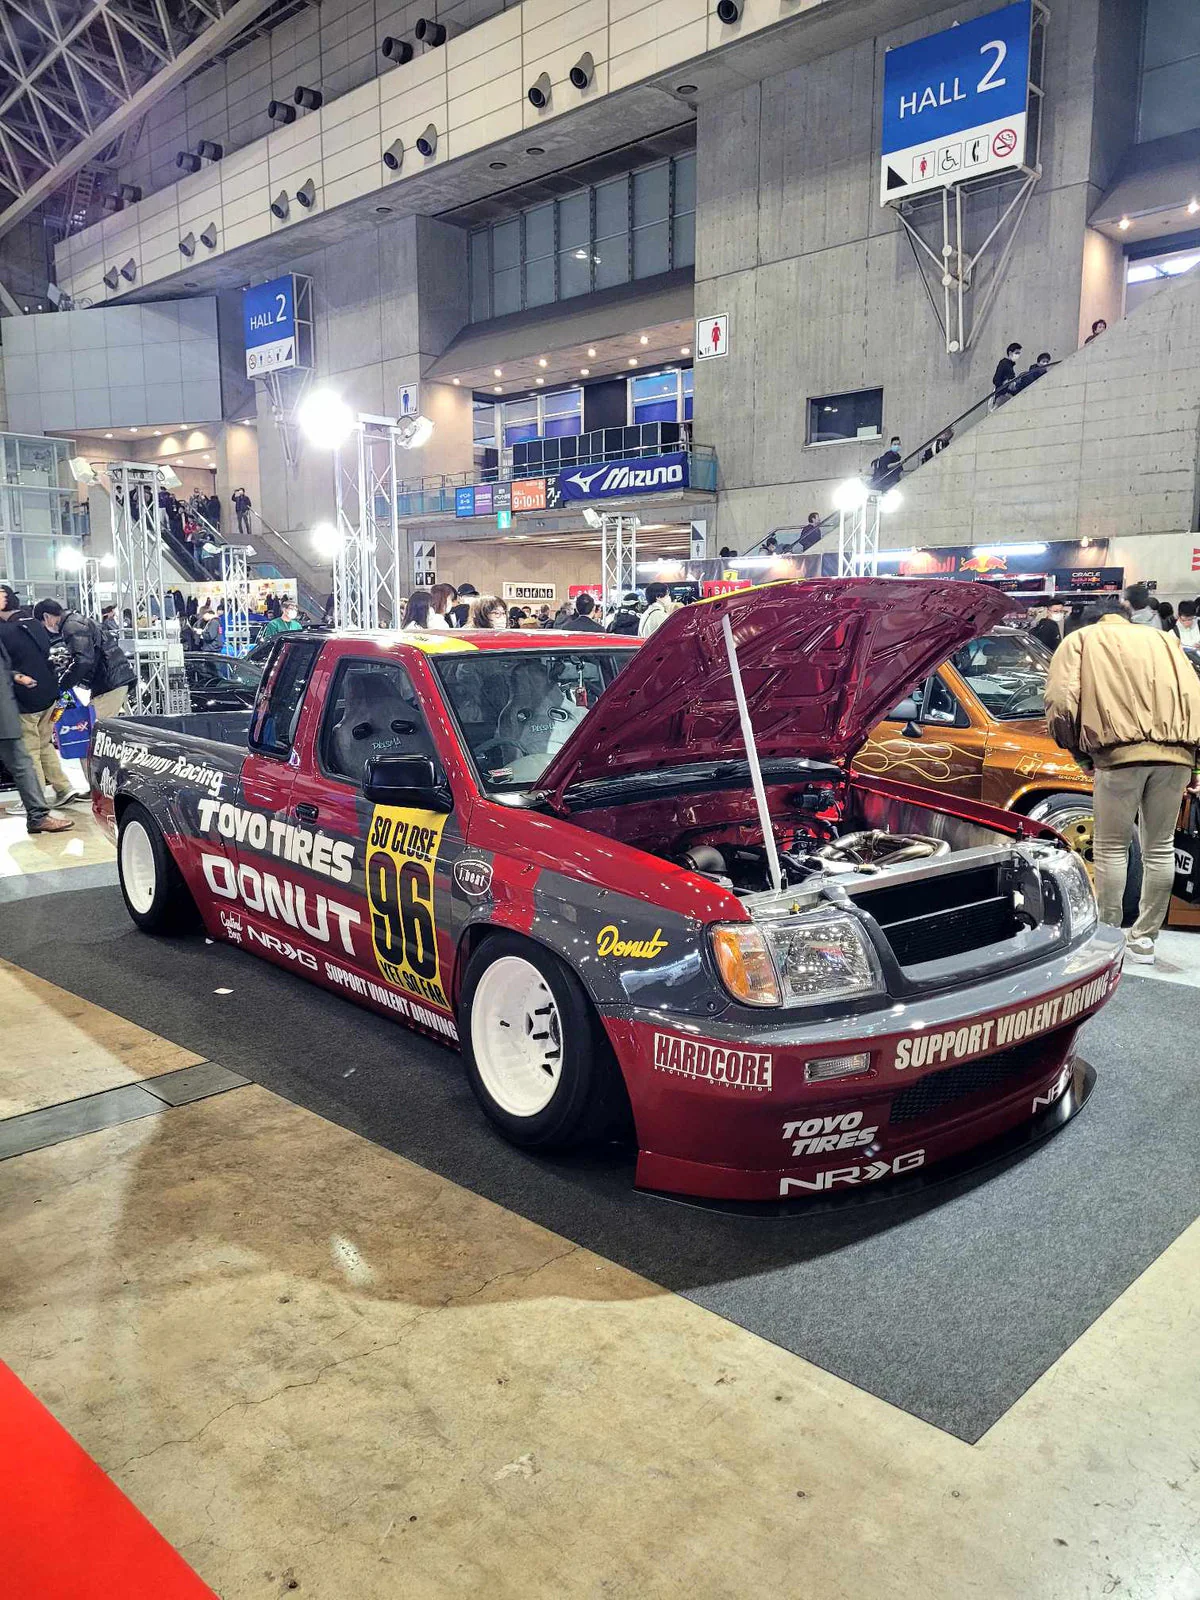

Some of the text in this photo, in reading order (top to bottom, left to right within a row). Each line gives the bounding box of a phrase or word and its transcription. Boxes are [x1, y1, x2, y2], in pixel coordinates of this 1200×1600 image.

[899, 39, 1008, 119] HALL 2
[250, 293, 287, 331] HALL 2
[547, 478, 556, 486] 2F
[600, 464, 683, 491] MIZUNO
[103, 736, 139, 763] Rocket
[131, 746, 177, 775] Bunny
[170, 755, 224, 797] Racing
[197, 799, 355, 884] TOYO TIRES
[371, 815, 438, 863] SO CLOSE
[1175, 852, 1191, 872] NE
[201, 852, 361, 957] DONUT
[368, 851, 437, 980] 96
[596, 924, 669, 959] Donut
[324, 961, 460, 1042] SUPPORT VIOLENT DRIVING
[379, 959, 450, 1009] YET SO FAR
[894, 971, 1110, 1070] SUPPORT VIOLENT DRIVING
[653, 1065, 773, 1092] RACING DIVISION
[656, 1034, 771, 1086] HARDCORE
[782, 1111, 864, 1140] TOYO
[791, 1125, 879, 1157] TIRES
